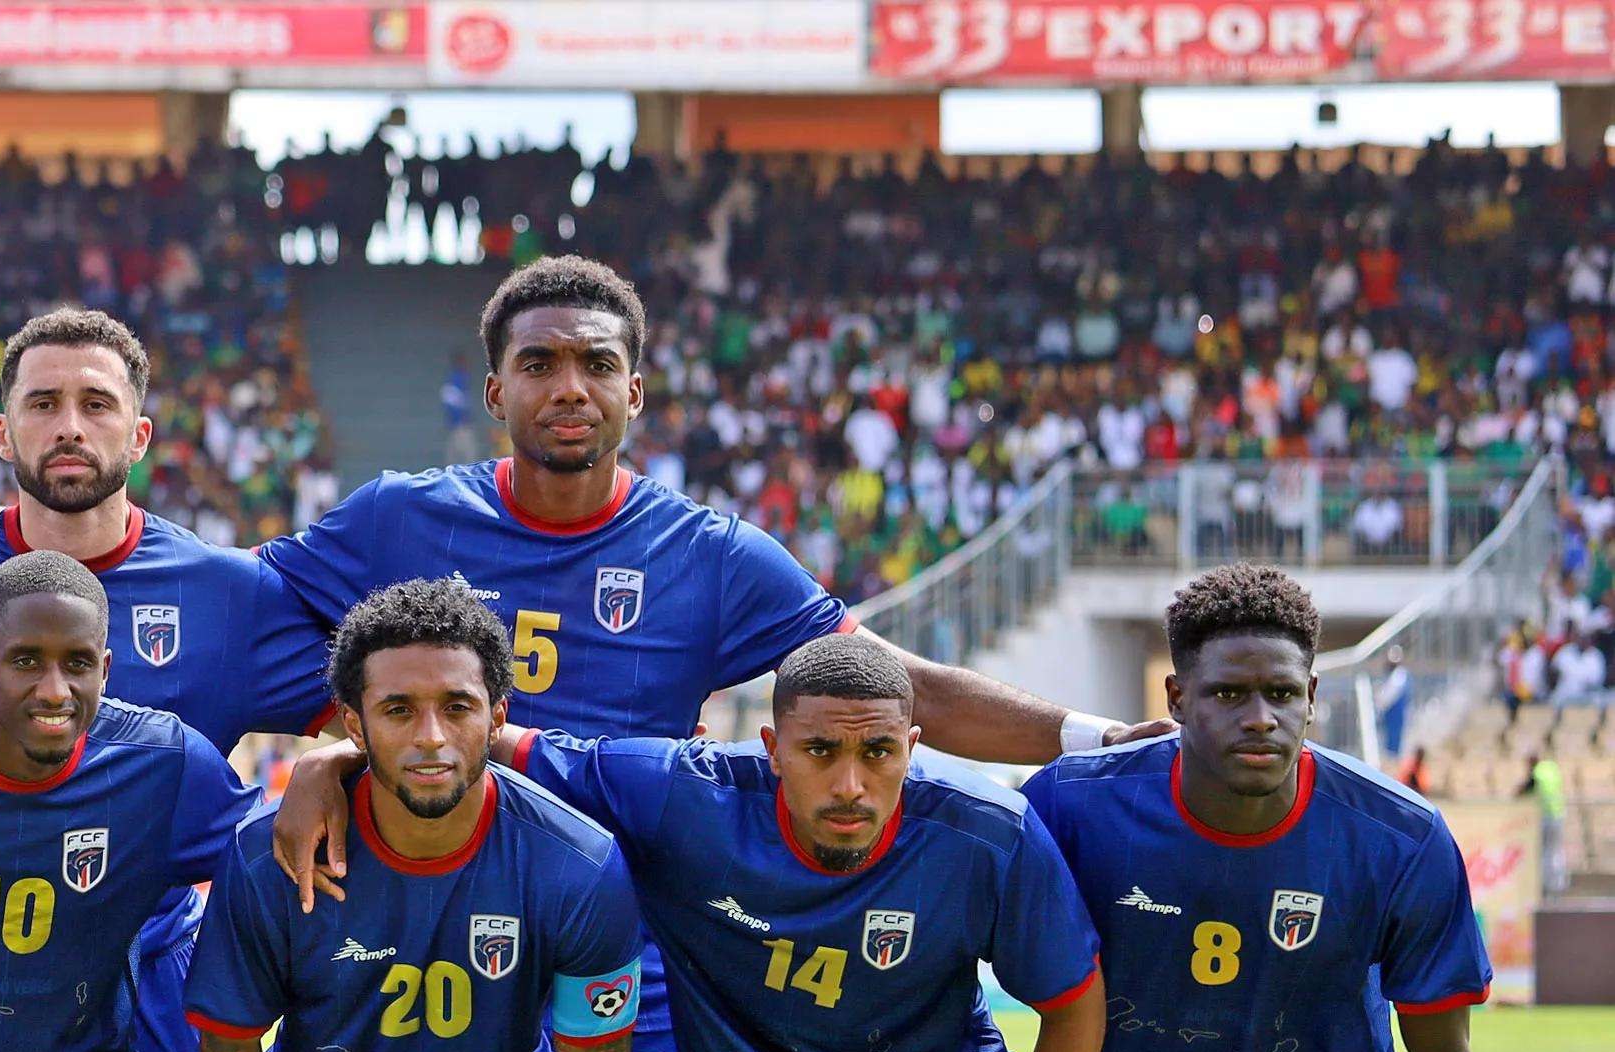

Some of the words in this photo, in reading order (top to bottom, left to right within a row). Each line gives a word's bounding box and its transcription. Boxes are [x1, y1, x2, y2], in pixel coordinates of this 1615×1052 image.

[1045, 4, 1362, 59] EXPORT
[600, 571, 640, 584] FCF
[136, 608, 175, 619] FCF
[513, 609, 561, 695] 5
[66, 831, 106, 846] FCF
[1277, 893, 1319, 906] FCF
[1138, 901, 1182, 916] tempo
[473, 918, 516, 930] FCF
[727, 908, 771, 932] tempo
[868, 913, 910, 925] FCF
[353, 945, 397, 962] tempo
[1190, 920, 1242, 986] 8
[761, 938, 849, 1009] 14
[379, 960, 473, 1038] 20
